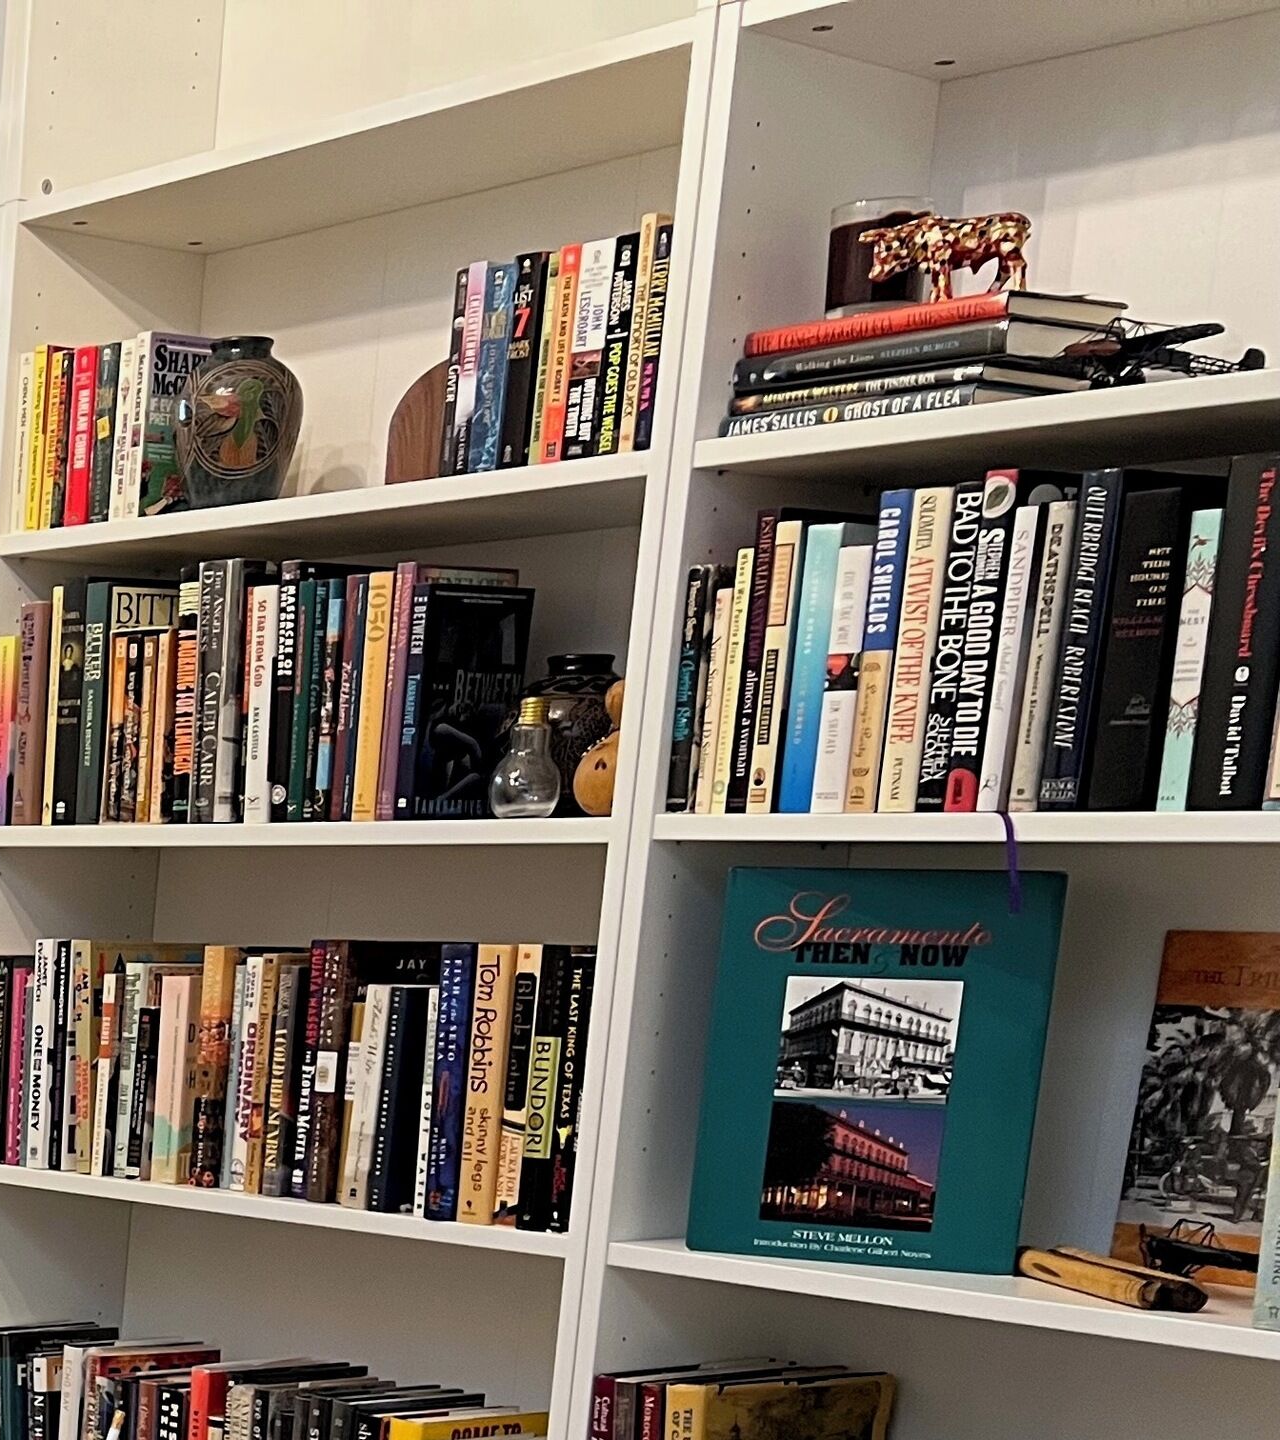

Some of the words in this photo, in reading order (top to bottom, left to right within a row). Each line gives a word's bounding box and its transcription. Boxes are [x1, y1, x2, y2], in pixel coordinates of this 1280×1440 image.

[650, 257, 669, 292] TERRY
[513, 289, 533, 302] LIST
[609, 270, 625, 325] PATTERSON
[620, 279, 633, 311] JAMES
[513, 308, 531, 338] 7
[575, 291, 592, 348] LESCROART
[592, 304, 604, 331] JOHN
[609, 343, 623, 365] POP
[153, 373, 186, 395] McC
[606, 367, 620, 393] GOES
[604, 395, 617, 415] THE
[727, 416, 767, 437] JAMES
[771, 411, 817, 431] SALLIS
[844, 400, 888, 421] GHOST
[892, 397, 909, 414] OF
[926, 388, 961, 409] FLEA
[875, 507, 902, 560] CAROL
[952, 491, 983, 544] BAD
[948, 545, 976, 581] TO
[867, 563, 895, 635] SHIELDS
[905, 569, 932, 624] TWIST
[1037, 524, 1065, 641] DEATHSPELL
[257, 600, 267, 613] SO
[940, 583, 970, 631] THE
[1069, 587, 1093, 634] REACH
[254, 635, 265, 662] FROM
[902, 628, 925, 648] OF
[966, 602, 996, 659] GOOD
[254, 665, 266, 687] GOD
[896, 651, 924, 687] THE
[931, 635, 963, 704] BONE
[959, 661, 987, 699] DAY
[1059, 645, 1085, 697] ROBERT
[203, 672, 220, 732] CALEB
[742, 670, 758, 713] almost
[889, 693, 918, 745] KNIFE
[955, 701, 980, 726] TO
[1052, 697, 1078, 750] STONE
[200, 735, 218, 785] CARR
[735, 728, 749, 777] woman
[951, 727, 979, 757] DIE
[754, 890, 992, 951] Sacramento
[396, 959, 427, 969] JAY
[794, 942, 871, 966] THEN
[900, 945, 970, 968] NOW
[477, 954, 500, 1001] Tom
[572, 968, 582, 991] THE
[568, 994, 580, 1022] LAST
[34, 1025, 43, 1057] ONE
[470, 1008, 497, 1093] Robbins
[565, 1026, 578, 1058] KING
[31, 1074, 42, 1131] MONEY
[525, 1041, 551, 1153] BUNDORI
[560, 1083, 572, 1119] TEXAS
[474, 1108, 490, 1156] skinny
[462, 1141, 474, 1162] all
[472, 1160, 488, 1192] legs
[682, 1408, 693, 1433] THE
